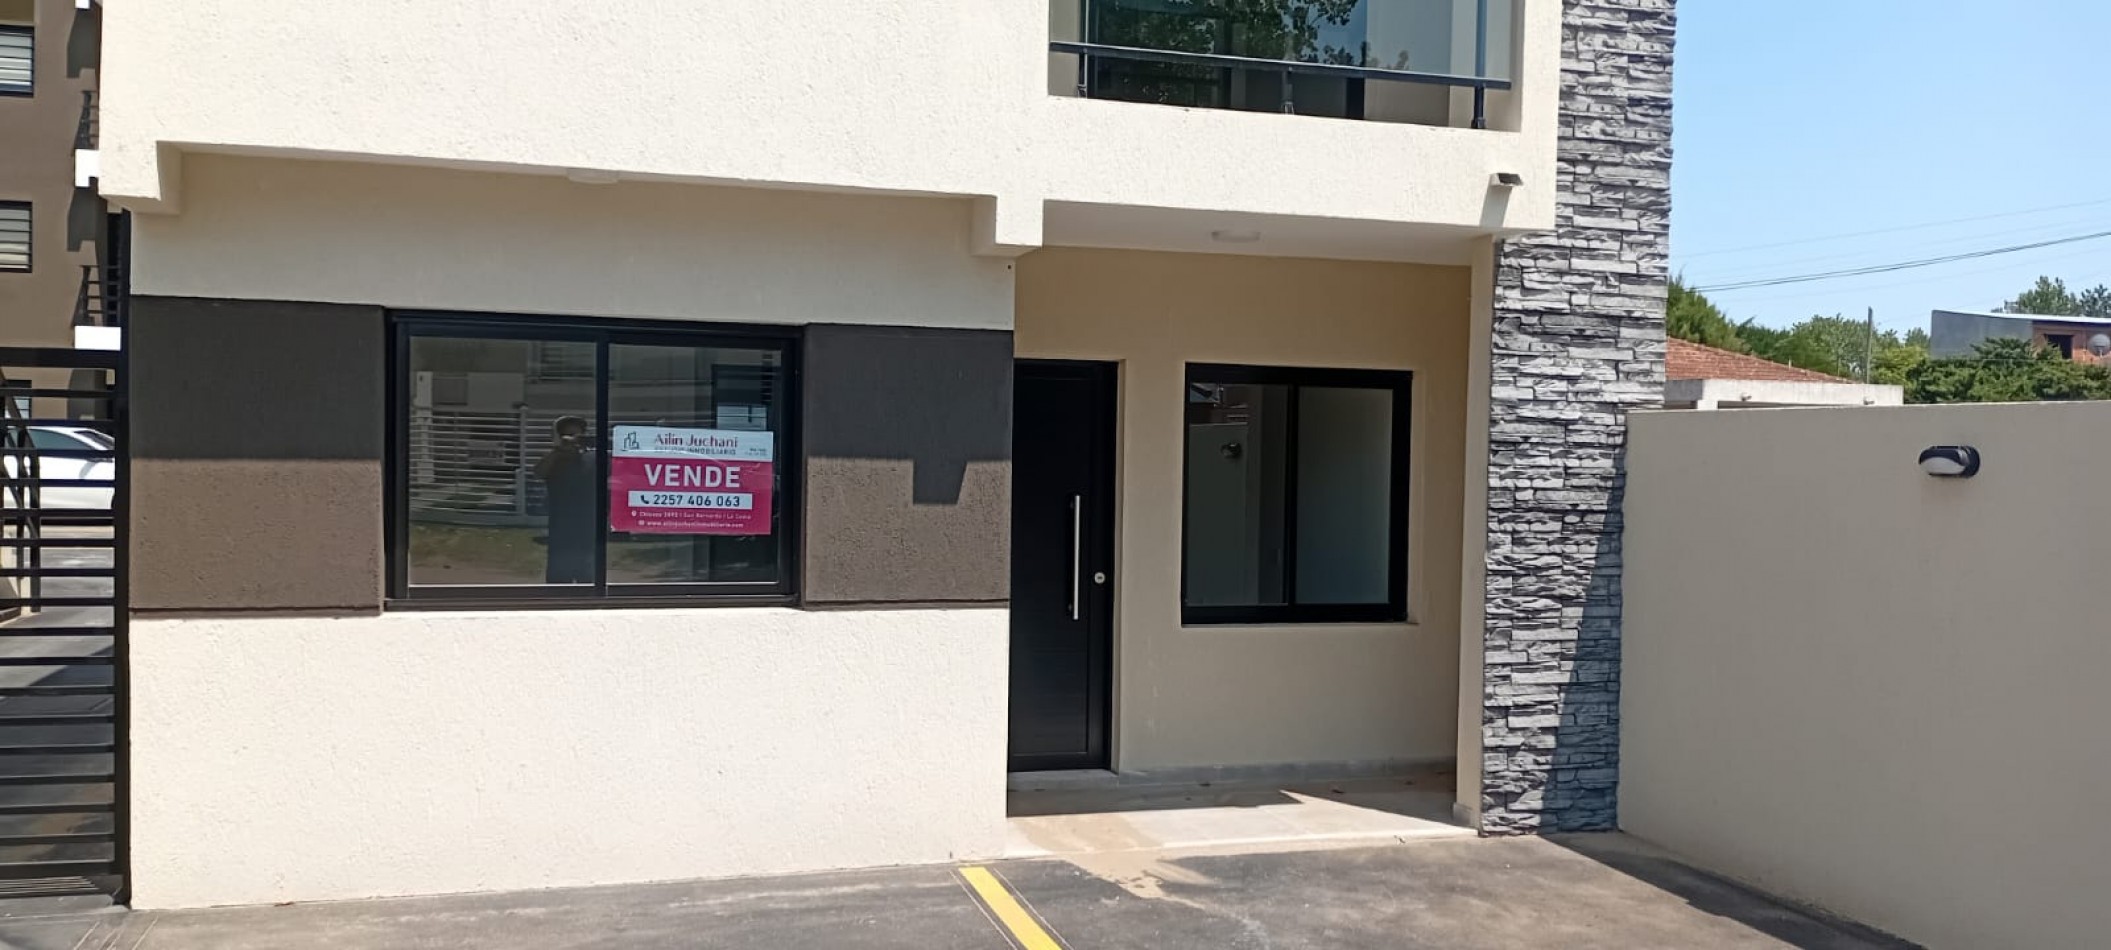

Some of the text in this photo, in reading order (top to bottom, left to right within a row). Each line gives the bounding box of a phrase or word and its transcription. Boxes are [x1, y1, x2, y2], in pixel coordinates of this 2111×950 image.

[655, 432, 739, 448] Ailin Juchani
[644, 463, 741, 488] VENDE
[653, 494, 740, 507] 2257 406 063
